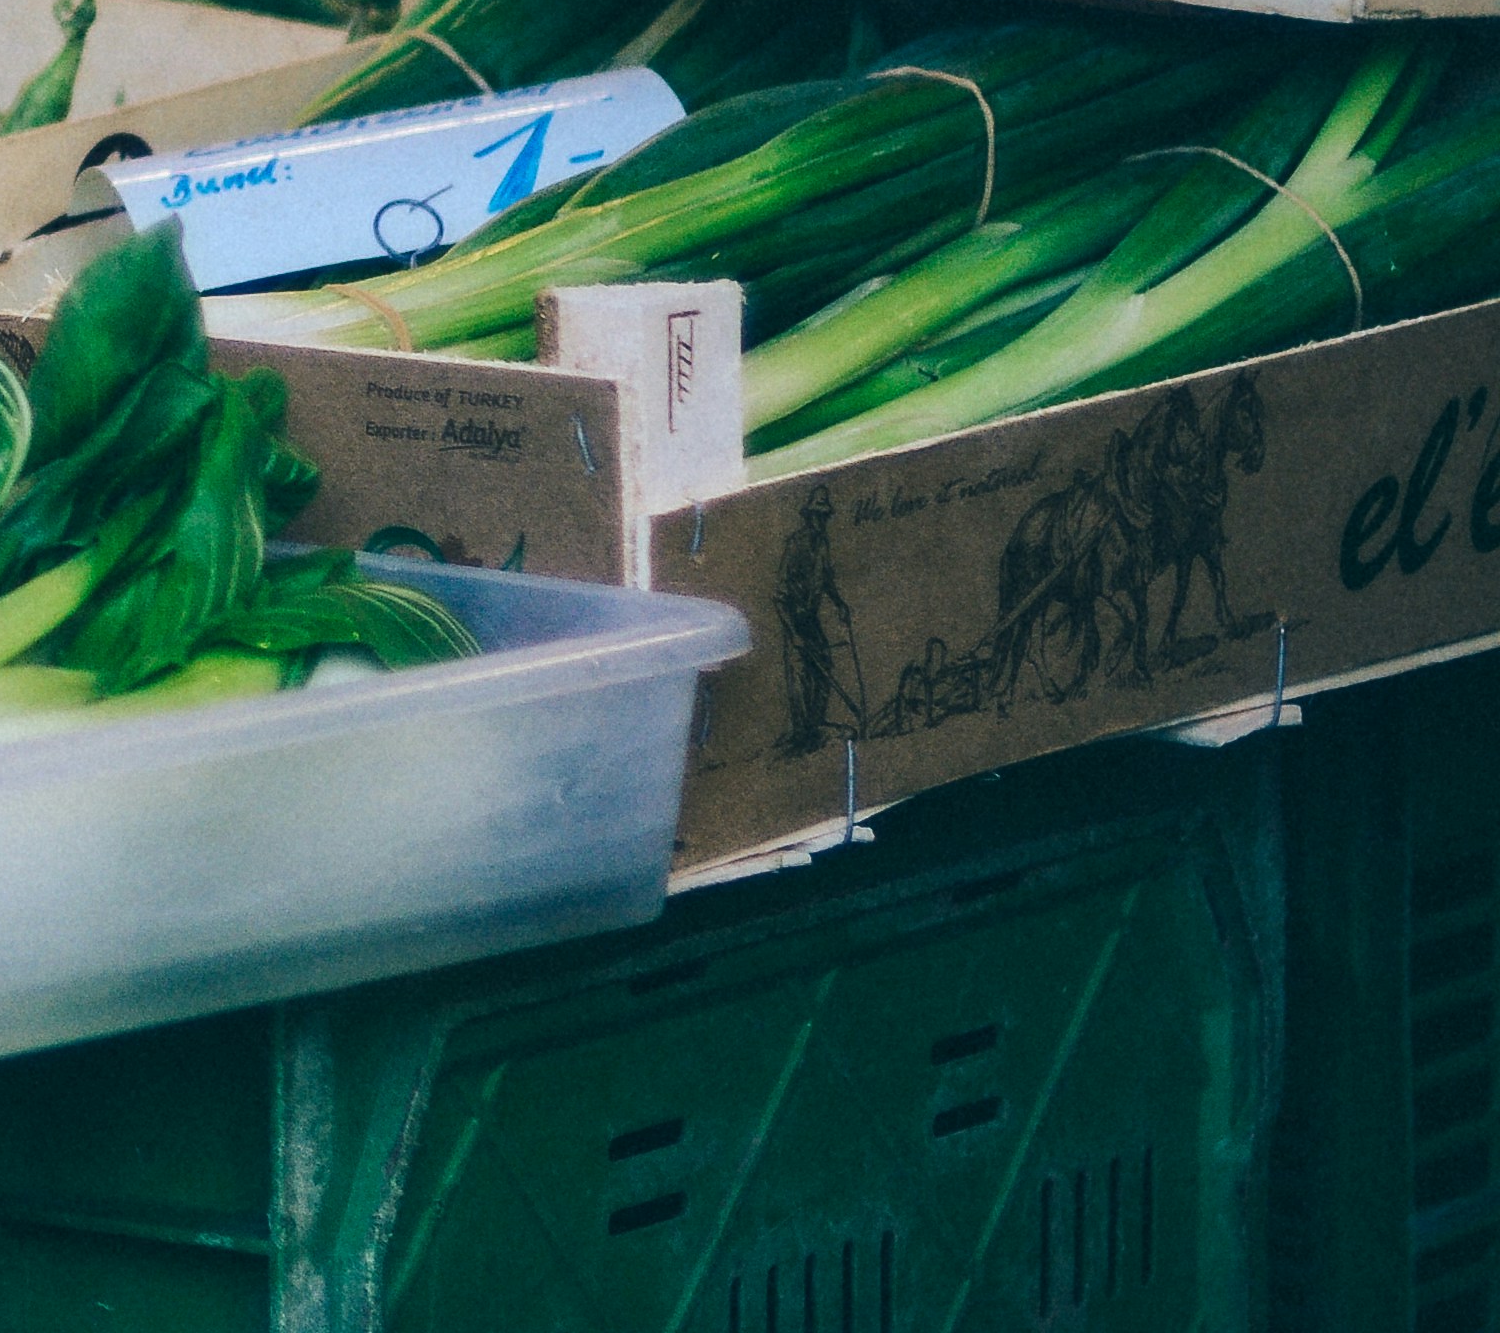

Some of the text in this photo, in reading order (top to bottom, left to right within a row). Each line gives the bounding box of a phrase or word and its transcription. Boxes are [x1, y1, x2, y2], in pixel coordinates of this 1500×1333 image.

[366, 381, 525, 410] Produce of TURKEY
